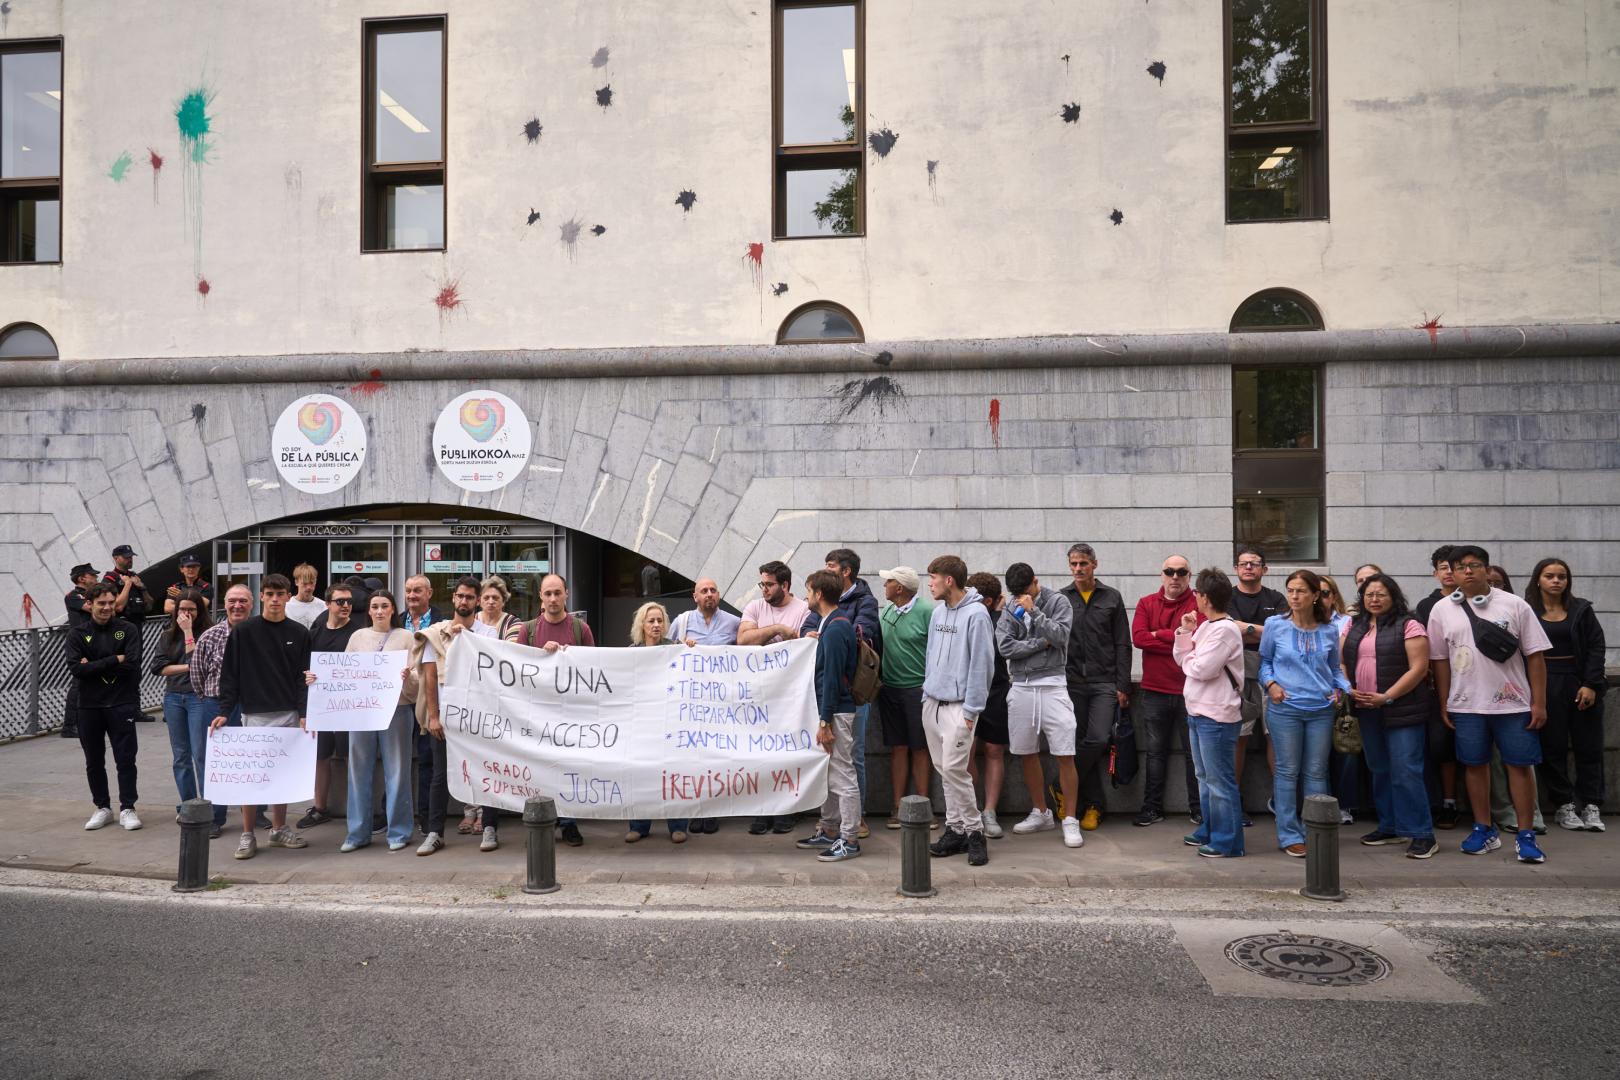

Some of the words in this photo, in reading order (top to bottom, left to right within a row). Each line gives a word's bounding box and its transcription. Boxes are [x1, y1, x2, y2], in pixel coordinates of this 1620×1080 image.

[281, 453, 295, 462] DE
[298, 453, 312, 462] LA
[316, 449, 359, 462] PÚBLICA
[441, 449, 511, 459] PUBLIKOKOA
[450, 525, 511, 535] HEZKUNTZA
[317, 653, 360, 667] GANAS
[374, 654, 389, 666] DE
[680, 651, 739, 673] TEMARIO
[746, 649, 789, 673] CLARO
[332, 669, 380, 679] ESTUDIAR
[478, 651, 540, 689] POR
[555, 666, 612, 694] UNA
[315, 682, 357, 692] TRABAS
[371, 682, 394, 690] PARA
[678, 678, 726, 701] TIEMPO
[738, 682, 753, 700] DE
[327, 695, 384, 711] AVANZAR
[679, 701, 769, 725] PREPARACIÓN
[445, 704, 513, 740] PRUEBA
[521, 727, 533, 737] DE
[538, 722, 619, 749] ACCESO
[212, 733, 283, 743] EDUCACIÓN
[676, 730, 738, 750] EXAMEN
[749, 729, 812, 752] MODELO
[213, 746, 288, 758] BLOQUEADA
[211, 760, 275, 769] JUVENTUD
[462, 760, 472, 786] A
[483, 761, 531, 781] GRADO
[210, 772, 271, 784] ATASCADA
[662, 767, 760, 801] ¡REVISIÓN
[771, 768, 802, 797] YA!
[482, 777, 541, 799] SUPERIOR
[559, 773, 623, 804] JUSTA
